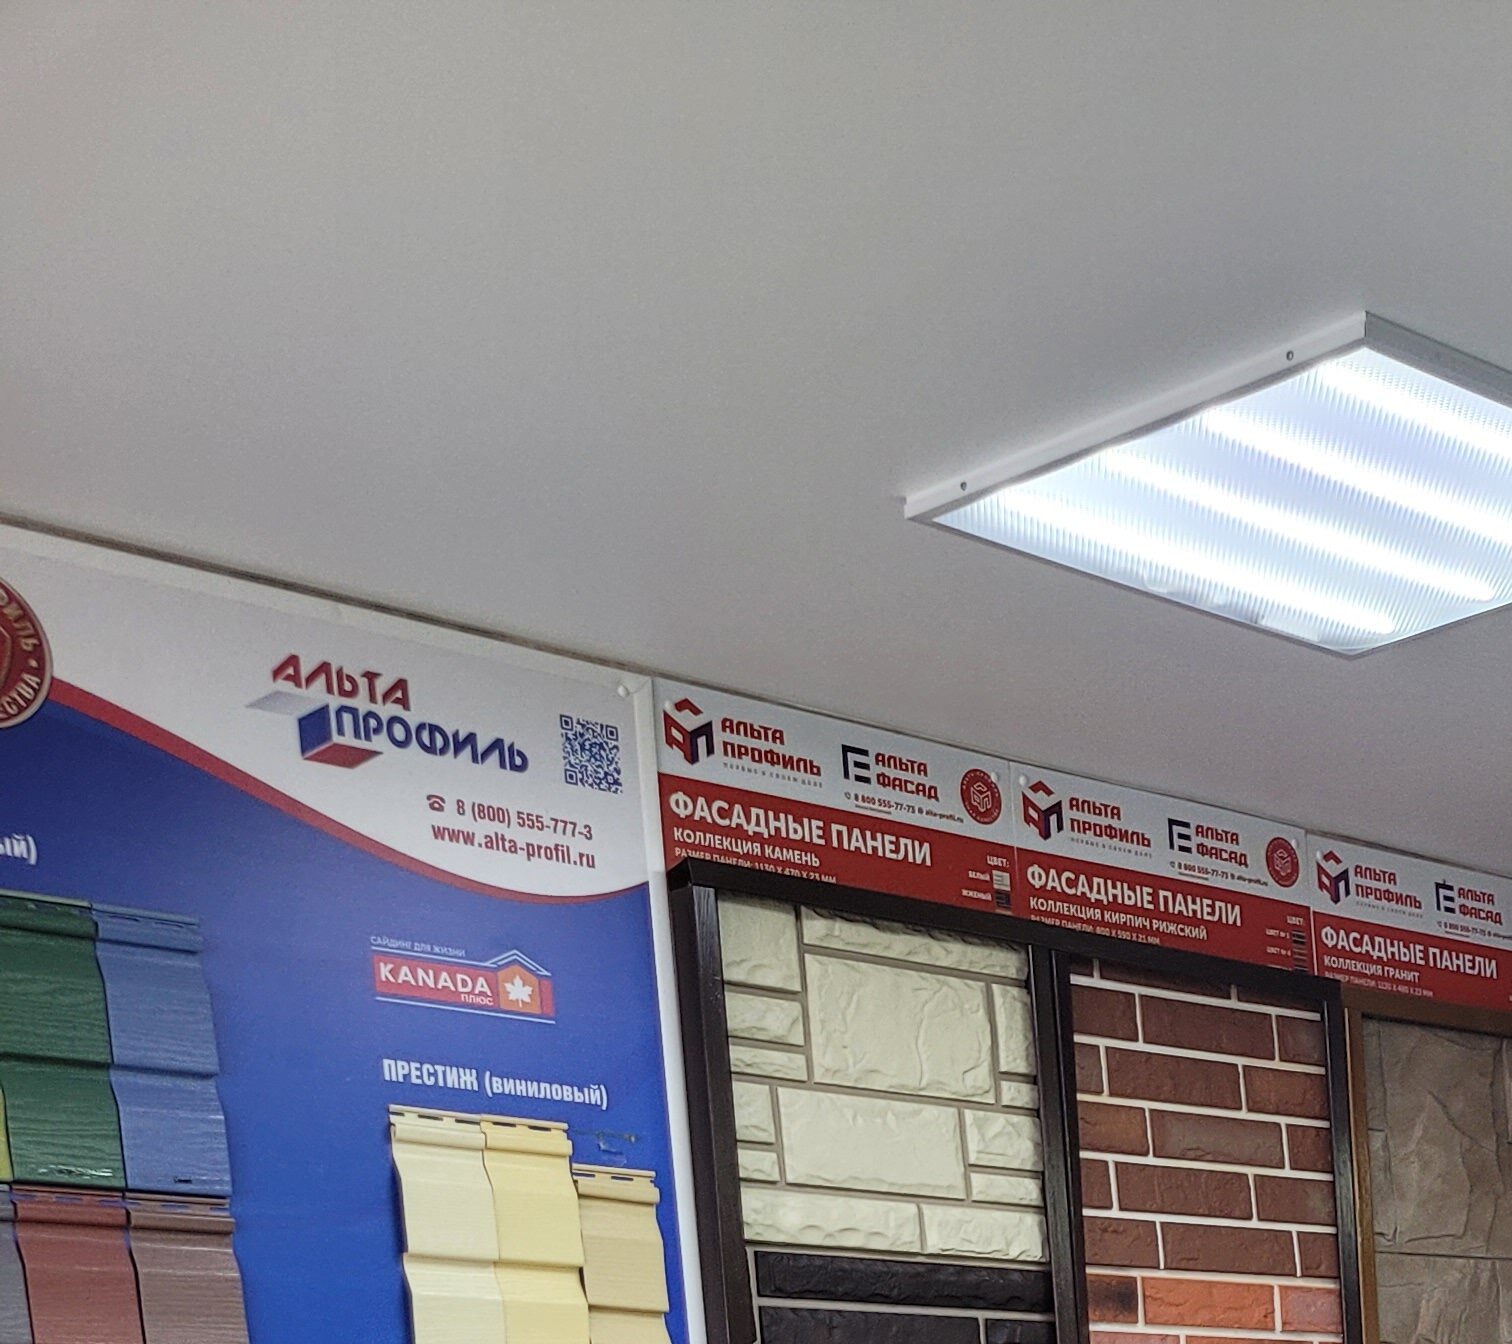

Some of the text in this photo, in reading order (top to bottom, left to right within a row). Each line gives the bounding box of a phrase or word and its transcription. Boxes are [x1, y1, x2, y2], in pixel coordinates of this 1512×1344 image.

[272, 653, 411, 711] АЛЬТА
[334, 704, 529, 773] ПРОФИЛЬ
[720, 717, 785, 746] АЛЬТА
[721, 740, 822, 777] ПРОФИЛЬ
[874, 752, 928, 777] АЛЬТА
[876, 771, 940, 802] ФАСАД
[456, 799, 593, 840] 8 (800) 555-777-3
[1069, 797, 1121, 821] АЛЬТА
[669, 791, 932, 866] ФАСАДНЫЕ ПАНЕЛИ
[1069, 818, 1151, 848] ПРОФИЛЬ
[1195, 825, 1239, 846] АЛЬТА
[431, 824, 596, 868] www.alta-profil.ru
[673, 827, 820, 867] КОЛЛЕКЦИЯ КАМЕНЬ
[1196, 842, 1248, 868] ФАСАД
[1354, 864, 1397, 886] АЛЬТА
[1026, 864, 1241, 927] ФАСАДНЫЕ ПАНЕЛИ
[1355, 883, 1422, 910] ПРОФИЛЬ
[1457, 887, 1495, 906] АЛЬТА
[1029, 896, 1208, 940] КОЛЛЕКЦИЯ КИРПИЧ РИЖСКИЙ
[1458, 903, 1503, 926] ФАСАД
[1321, 926, 1426, 965] ФАСАДНЫЕ
[1428, 946, 1498, 979] ПАНЕЛИ
[379, 962, 492, 996] KANADA
[1323, 955, 1420, 983] КОЛЛЕКЦИЯ ГРАНИТ
[461, 993, 494, 1005] ПЛЮС
[382, 1058, 607, 1110] ПРЕСТИЖ (виниловый)
